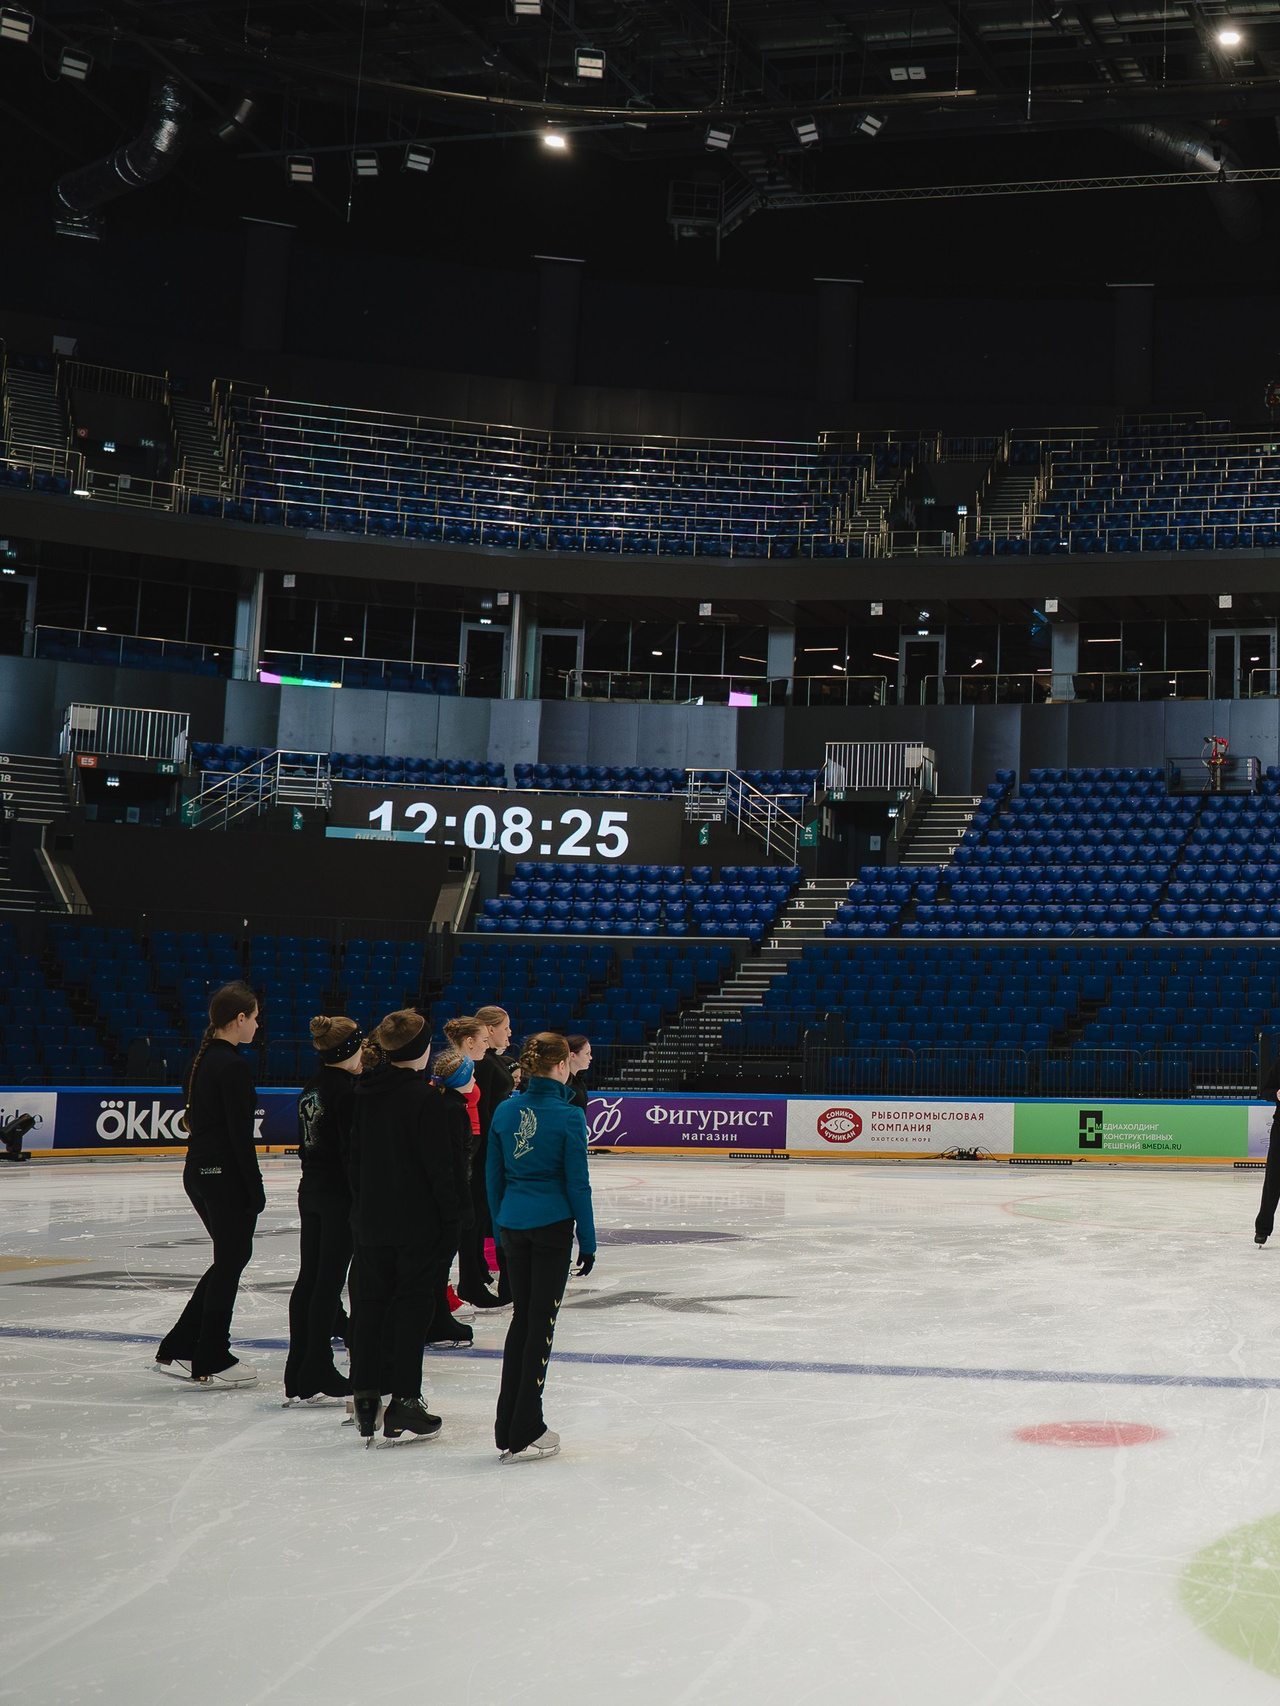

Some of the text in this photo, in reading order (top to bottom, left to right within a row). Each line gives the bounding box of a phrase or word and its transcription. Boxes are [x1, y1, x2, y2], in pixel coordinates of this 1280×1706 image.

[81, 757, 94, 766] E5
[162, 764, 174, 773] H1
[833, 792, 843, 800] H1
[806, 881, 816, 889] 14
[795, 901, 805, 909] 13
[782, 920, 791, 928] 12
[770, 940, 778, 948] 11
[645, 1105, 773, 1130] Фигурист
[825, 1108, 854, 1120] СОНИКО
[871, 1111, 984, 1121] РЫБОПРОМЫСЛОВАЯ
[871, 1123, 932, 1132] КОМПАНИЯ
[1095, 1123, 1159, 1131] МЕДИАХОЛДИНГ
[682, 1131, 738, 1142] магазин
[824, 1130, 856, 1141] ЧУМИКАН
[1103, 1133, 1173, 1141] КОНСТРУКТИВНЫХ
[1103, 1142, 1140, 1150] РЕШЕНИЙ
